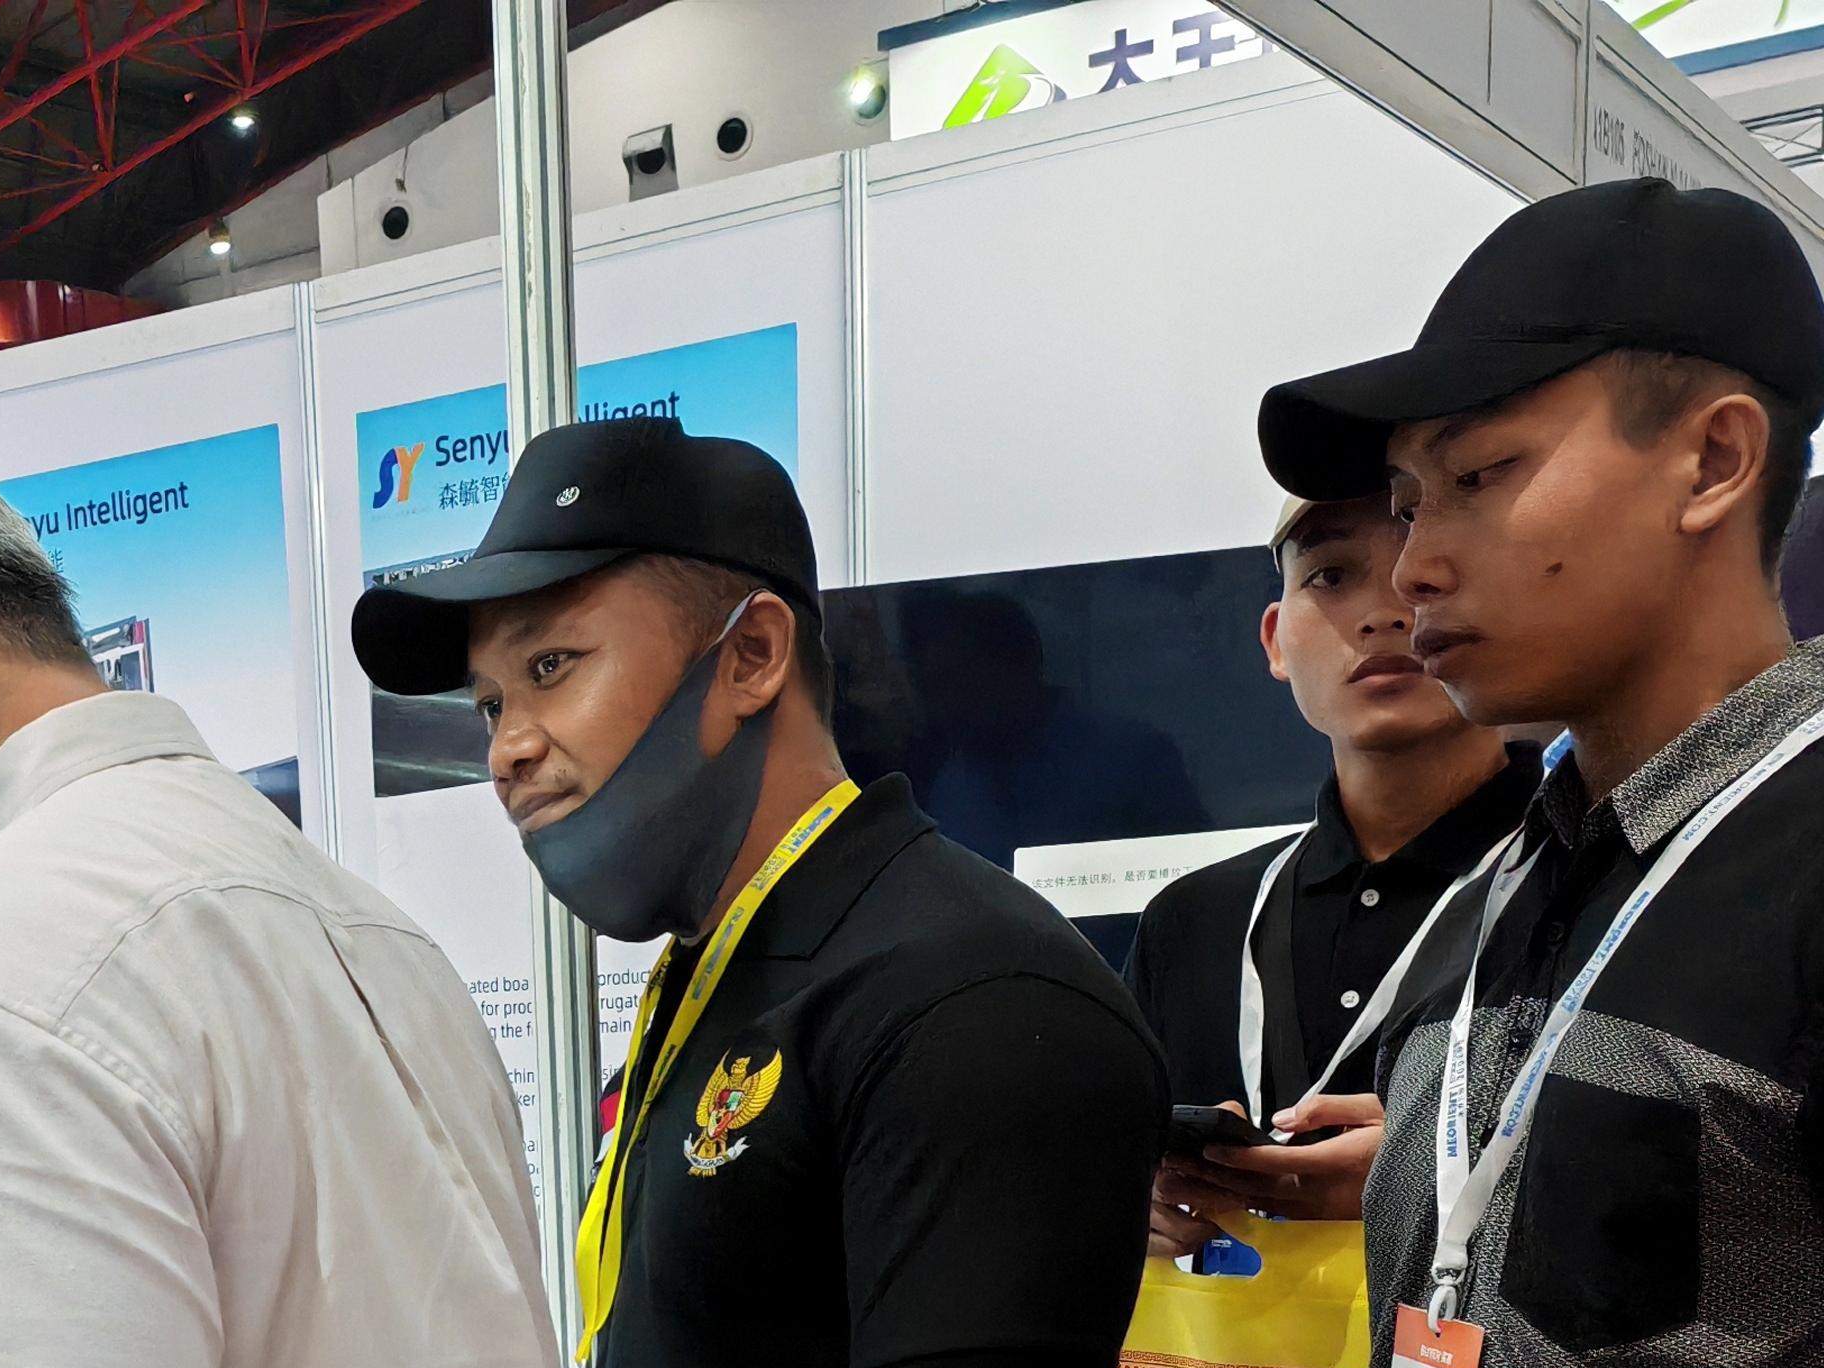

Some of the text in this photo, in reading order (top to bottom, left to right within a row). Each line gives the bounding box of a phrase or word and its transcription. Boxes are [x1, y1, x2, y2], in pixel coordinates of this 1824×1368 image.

[439, 473, 510, 511] 森毓智
[25, 481, 190, 542] yu Intelligent
[464, 977, 498, 994] ated
[481, 1000, 499, 1016] for
[501, 1022, 523, 1039] the
[1446, 1090, 1459, 1159] MEORIENT
